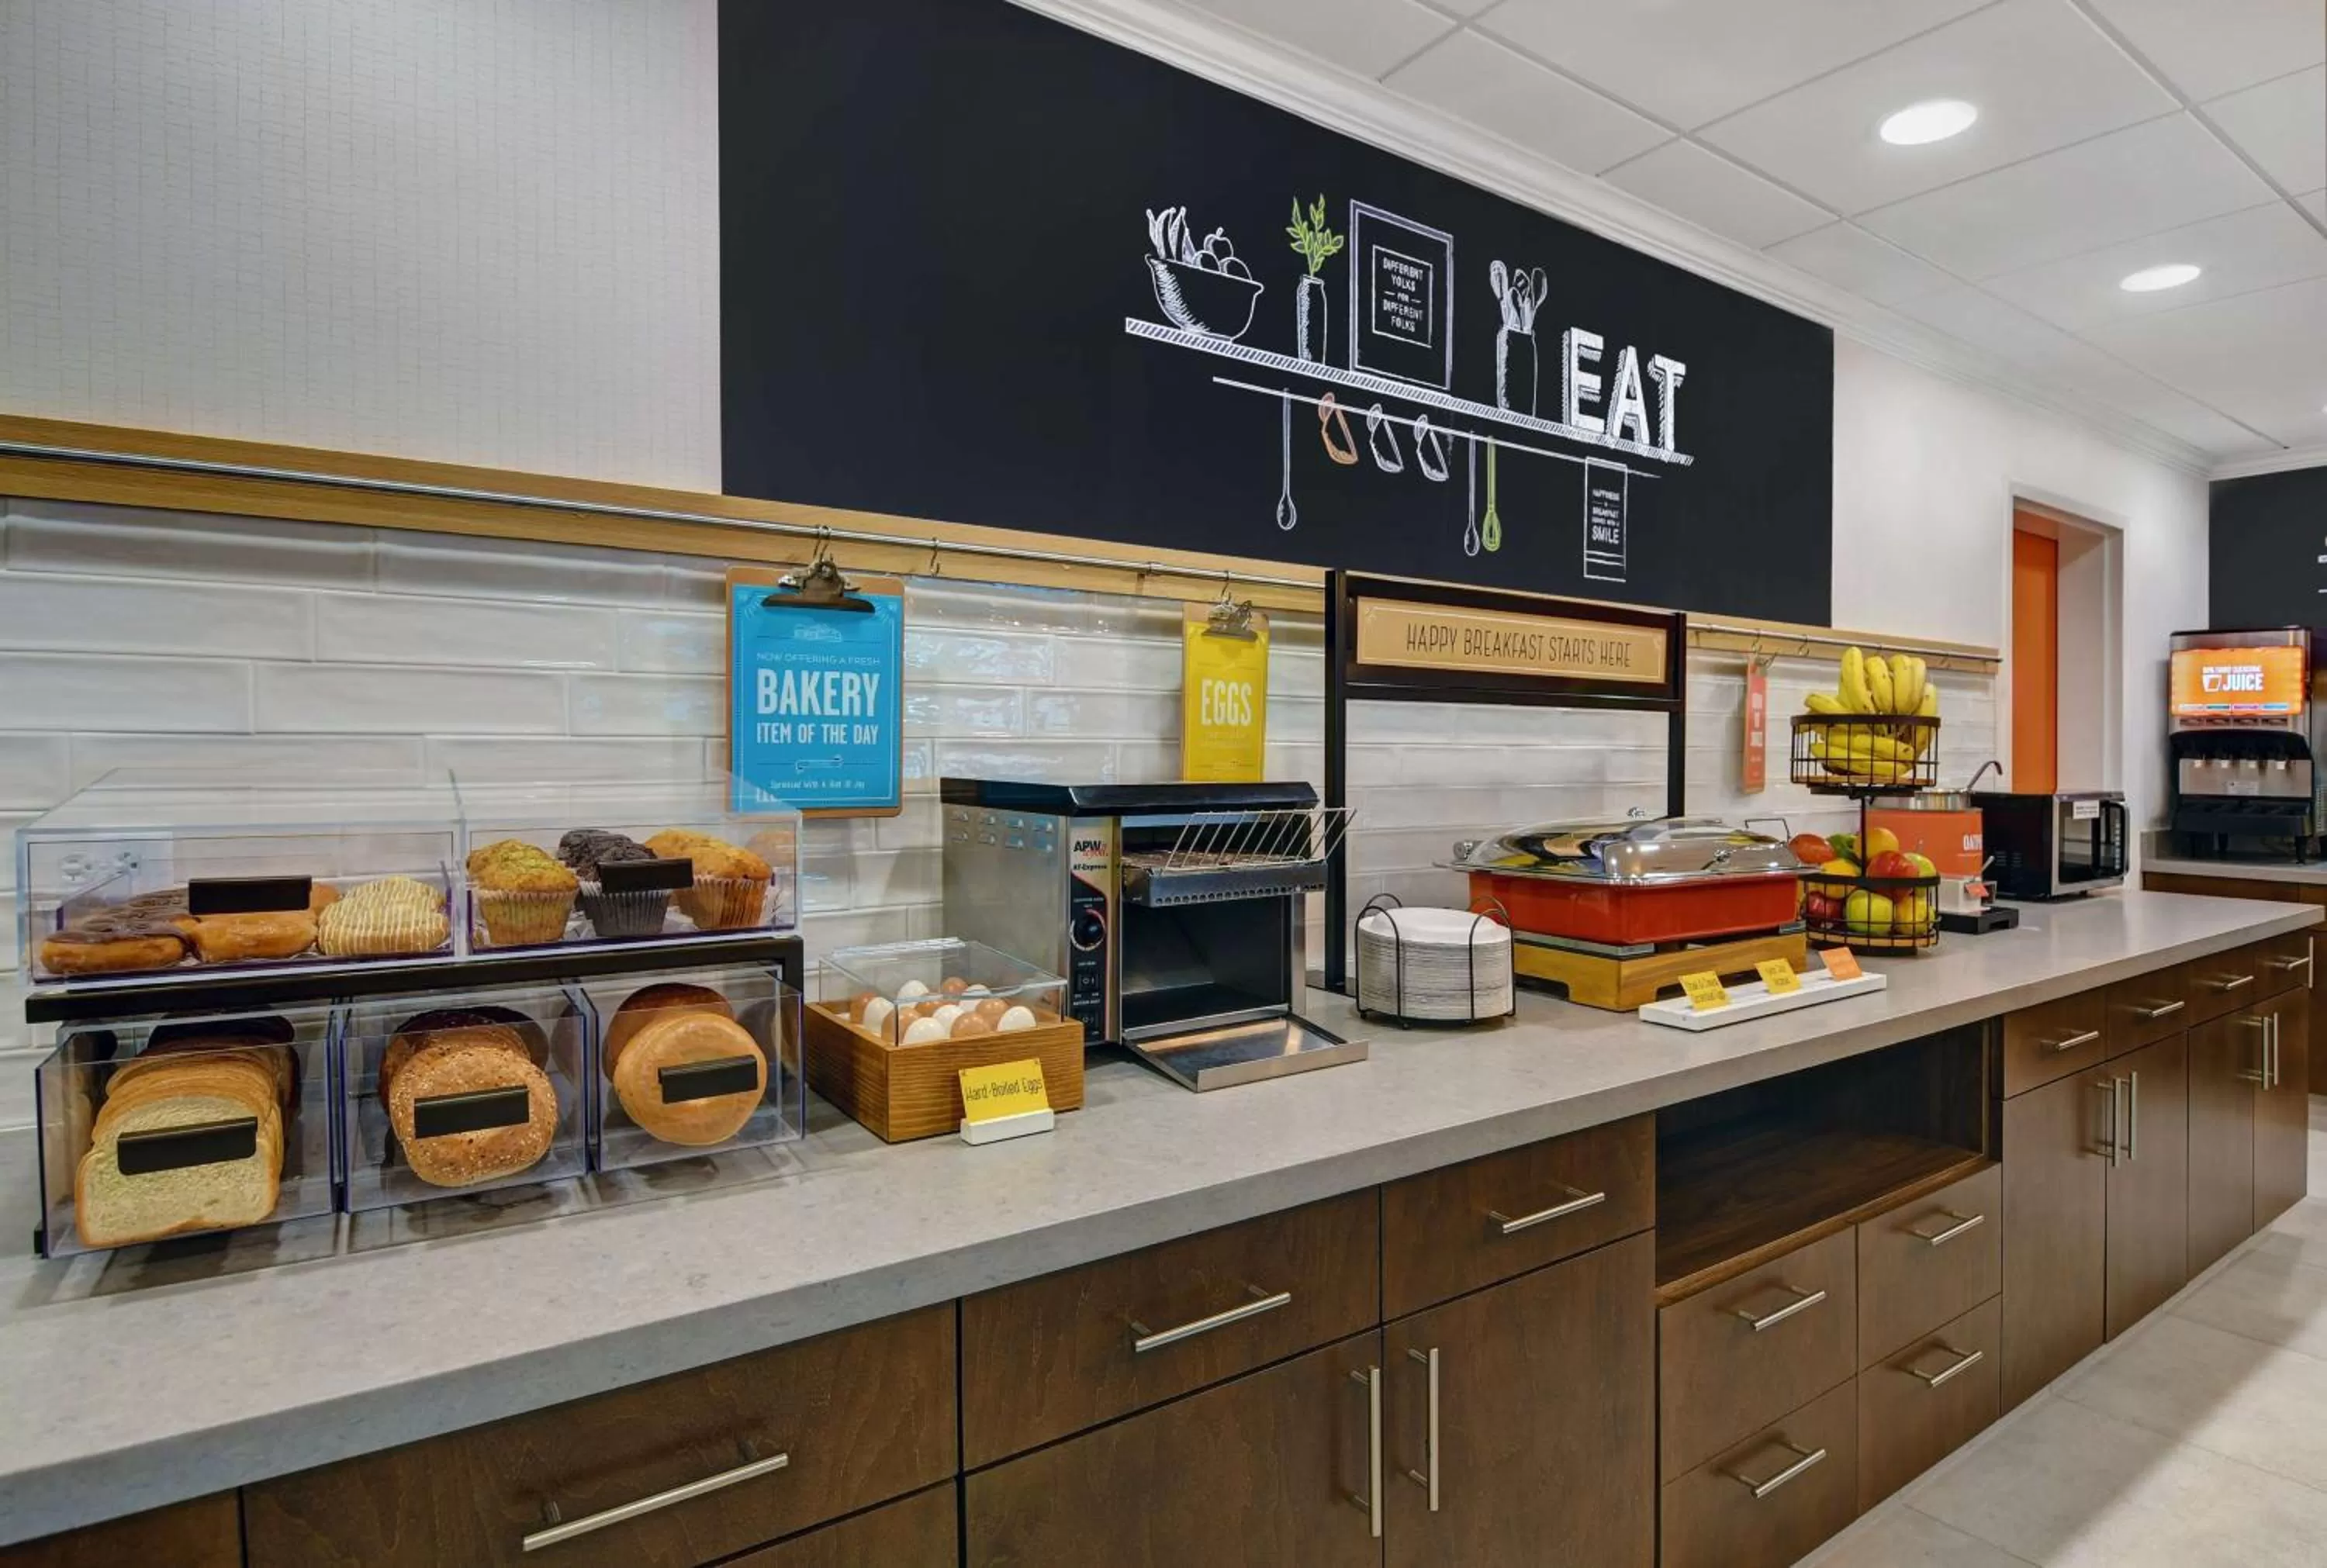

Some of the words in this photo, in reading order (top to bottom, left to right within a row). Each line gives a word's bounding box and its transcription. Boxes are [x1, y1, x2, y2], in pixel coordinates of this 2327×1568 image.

[1391, 274, 1416, 292] YOLKS
[1562, 326, 1686, 452] EAT
[1592, 525, 1620, 544] SMILE
[1406, 623, 1457, 653] HAPPY
[1464, 628, 1544, 661] BREAKFAST
[1549, 636, 1595, 665] STARTS
[1600, 640, 1633, 668] HERE
[757, 652, 783, 661] NOW
[849, 657, 880, 665] FRESH
[2223, 673, 2264, 691] JUICE
[757, 668, 880, 717] BAKERY
[1201, 679, 1252, 727] EGGS
[756, 722, 792, 744] ITEM
[798, 723, 815, 744] OF
[821, 724, 848, 744] THE
[853, 724, 879, 745] DAY
[1074, 840, 1102, 852] APW
[1022, 1076, 1043, 1095] Eggs
